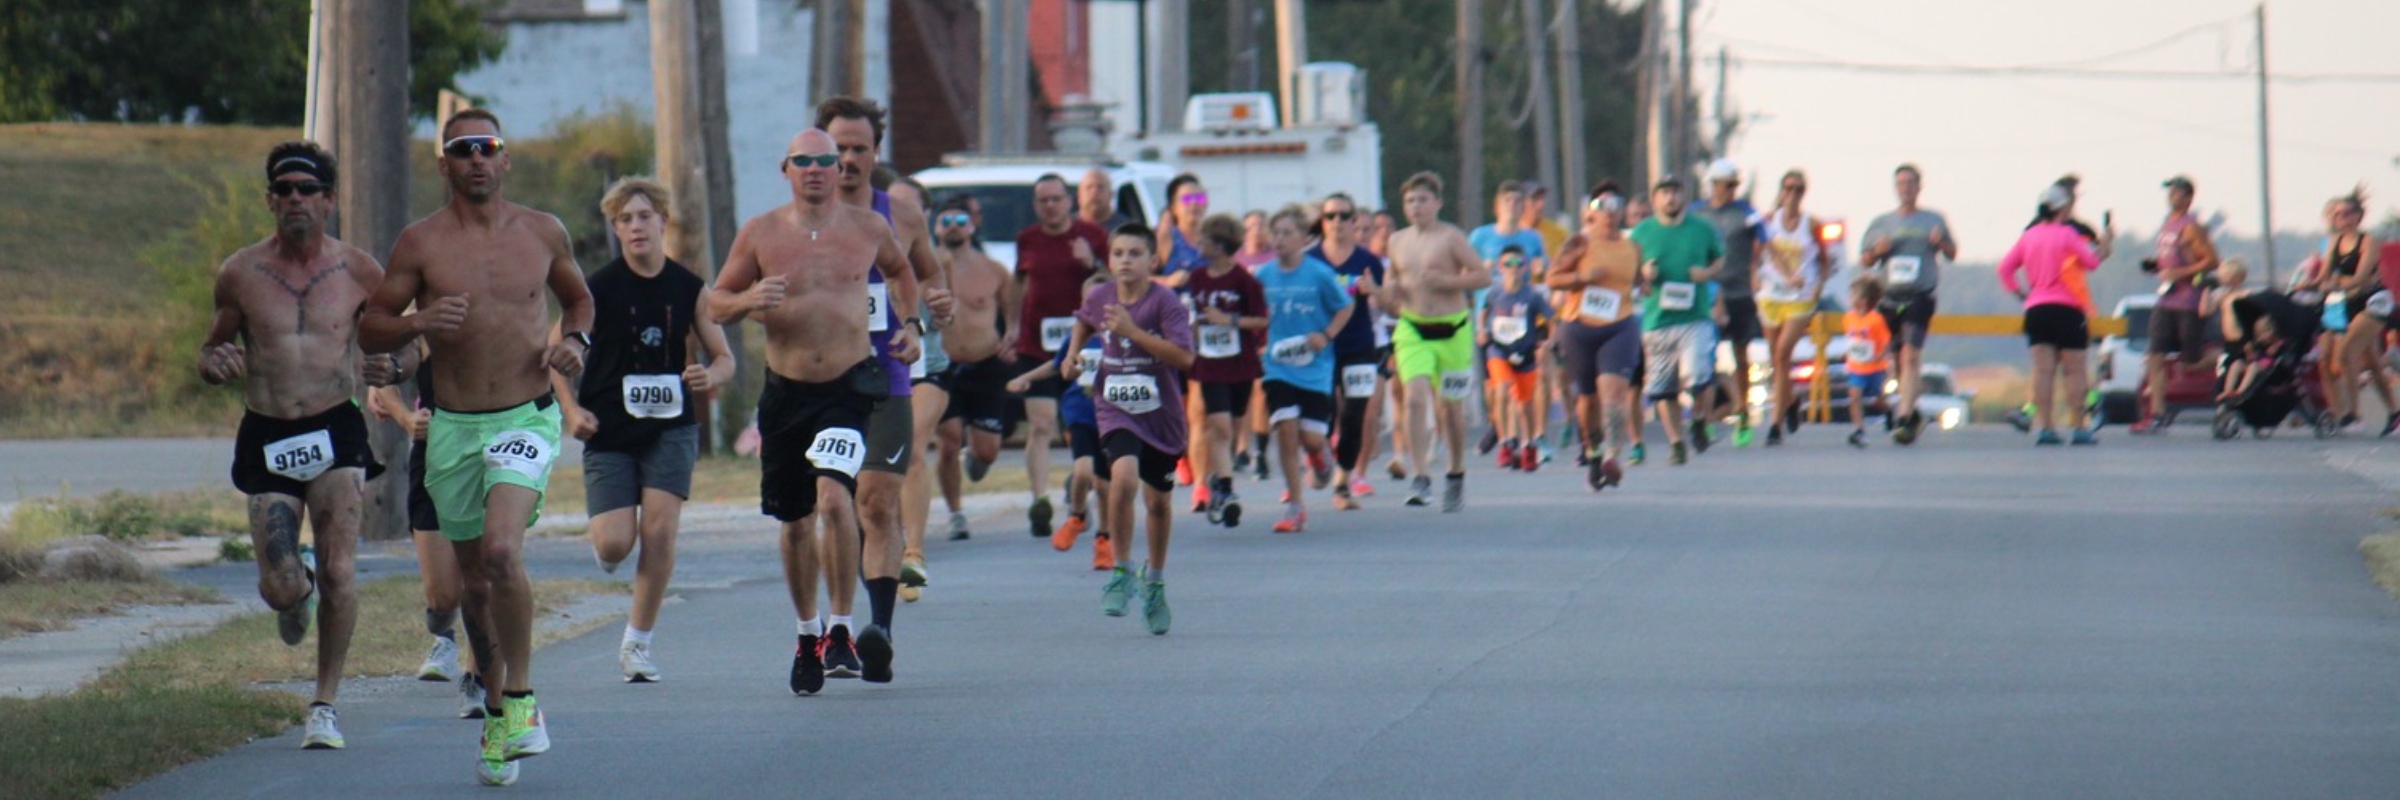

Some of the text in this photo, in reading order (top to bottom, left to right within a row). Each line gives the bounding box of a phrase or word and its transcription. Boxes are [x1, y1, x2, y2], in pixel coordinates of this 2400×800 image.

[630, 386, 673, 404] 9790
[1108, 386, 1151, 402] 9839
[274, 443, 323, 472] 9754
[815, 437, 857, 459] 9761
